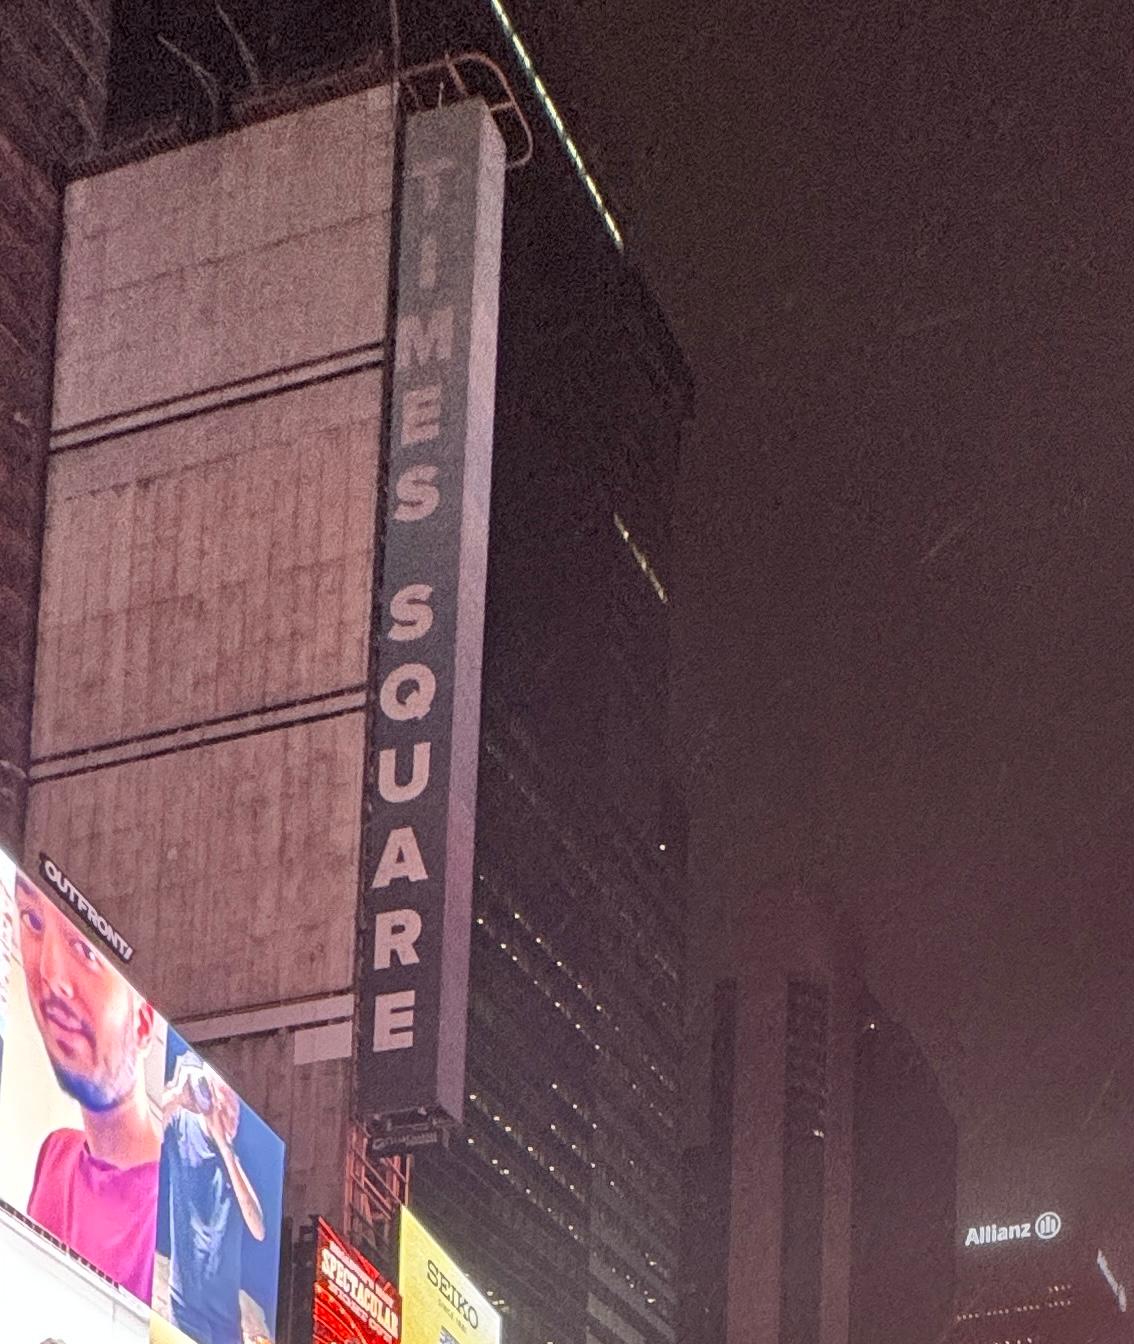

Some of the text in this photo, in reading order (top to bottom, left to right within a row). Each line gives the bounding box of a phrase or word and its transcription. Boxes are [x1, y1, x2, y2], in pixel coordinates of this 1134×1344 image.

[372, 159, 457, 1051] TIMES SQUARE
[964, 1223, 1032, 1246] Allianz
[427, 1259, 479, 1330] SEIKO
